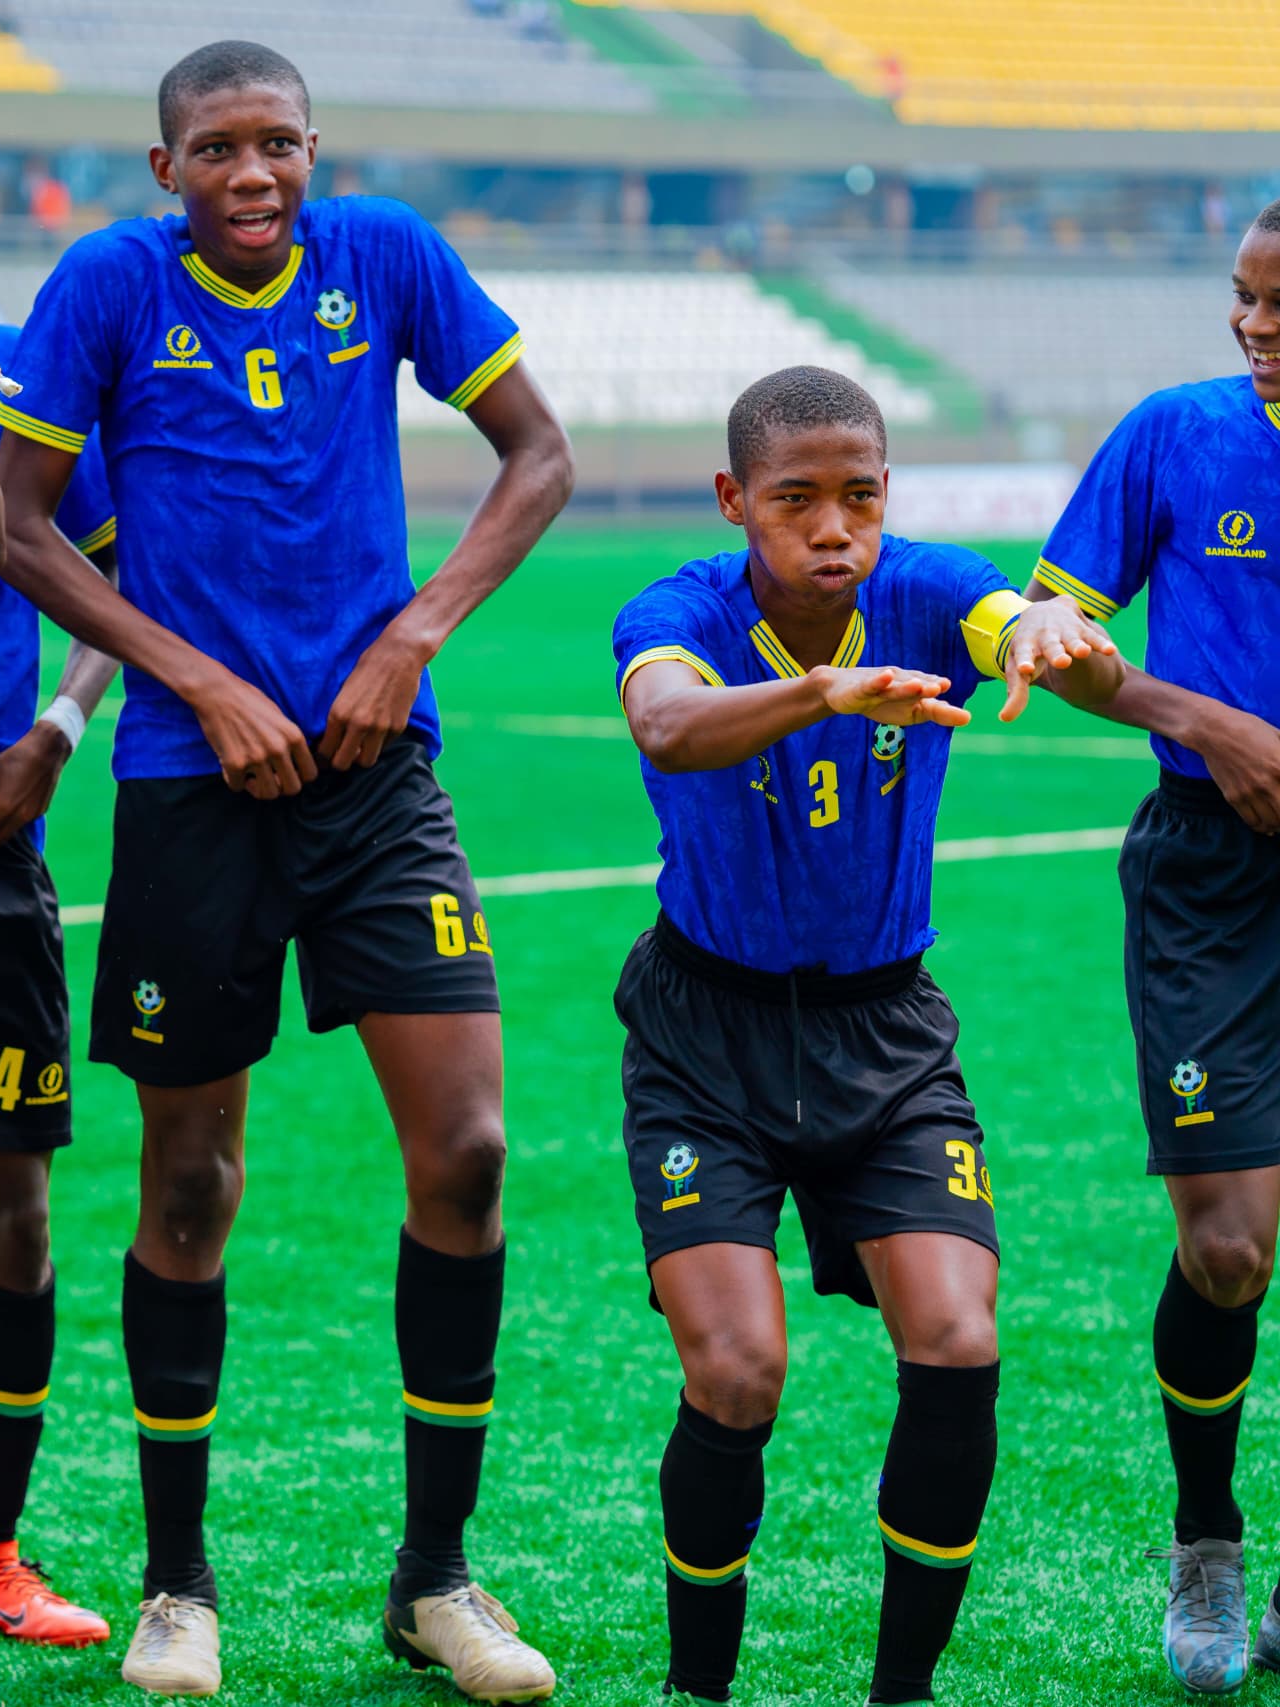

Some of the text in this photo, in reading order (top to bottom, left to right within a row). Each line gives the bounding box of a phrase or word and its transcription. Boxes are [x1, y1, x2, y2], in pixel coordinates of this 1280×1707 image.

[245, 348, 285, 410] 6
[1205, 547, 1267, 559] SANDALAND
[809, 760, 840, 828] 3
[430, 893, 467, 957] 6
[945, 1140, 978, 1201] 3
